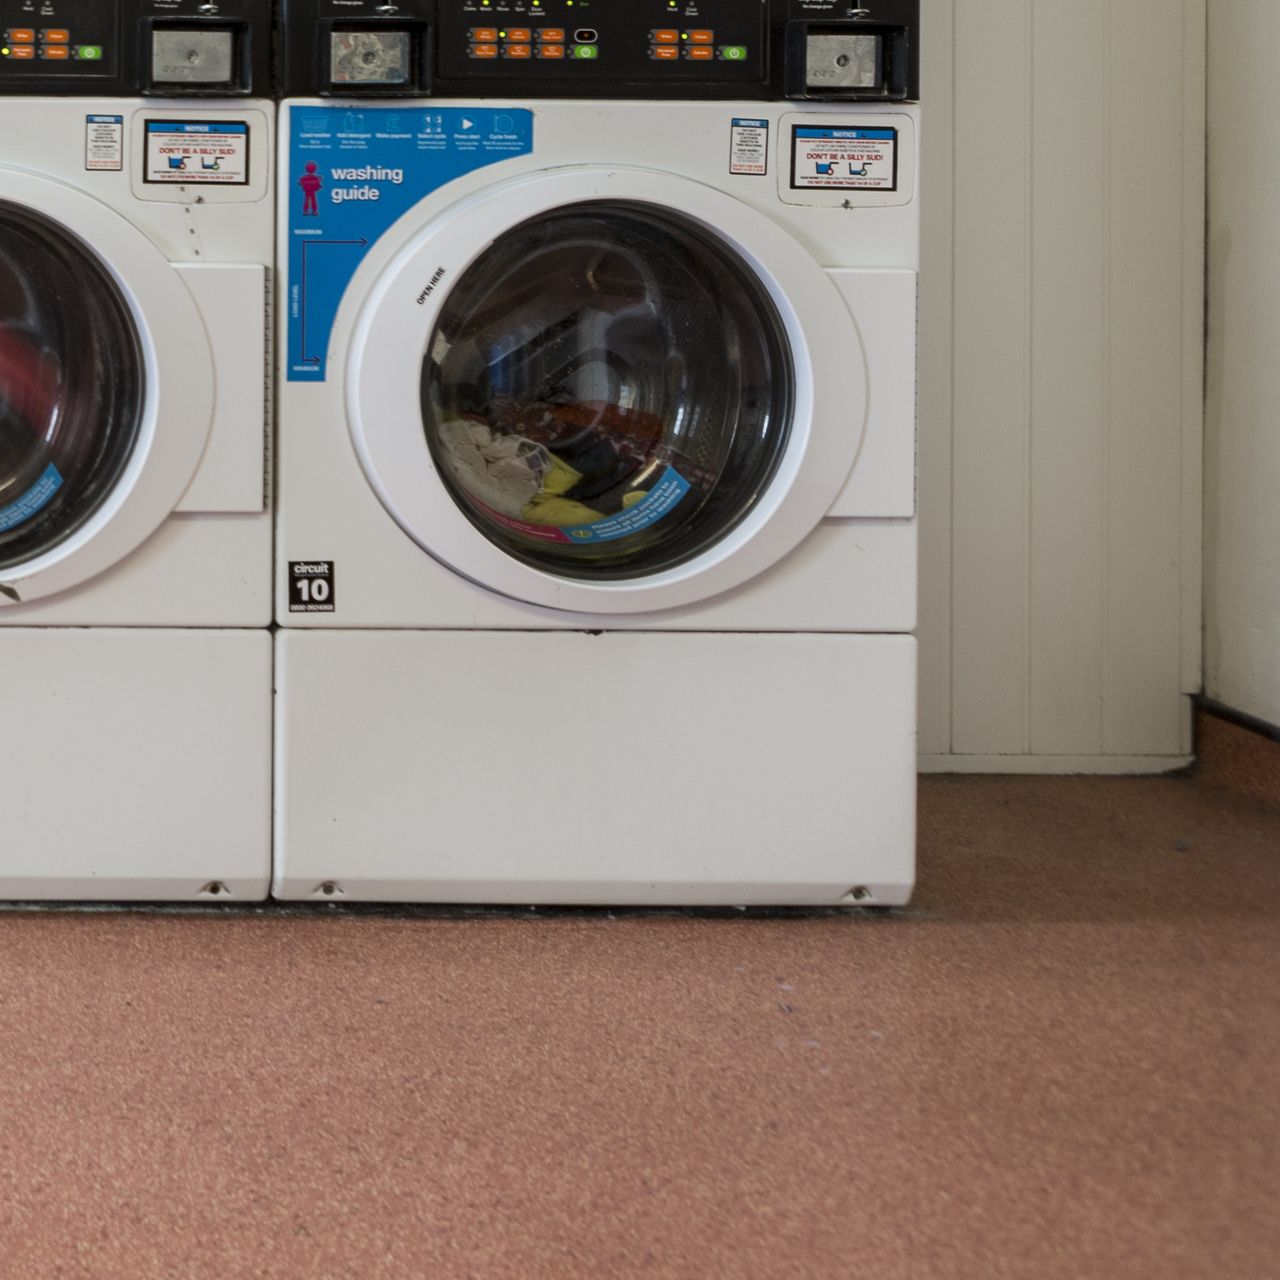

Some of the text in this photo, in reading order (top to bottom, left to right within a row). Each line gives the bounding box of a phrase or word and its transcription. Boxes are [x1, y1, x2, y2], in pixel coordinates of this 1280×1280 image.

[331, 164, 403, 185] washing
[331, 184, 380, 203] guide
[416, 266, 446, 305] OPEN HERE
[294, 562, 329, 573] circuit
[297, 579, 329, 601] 10
